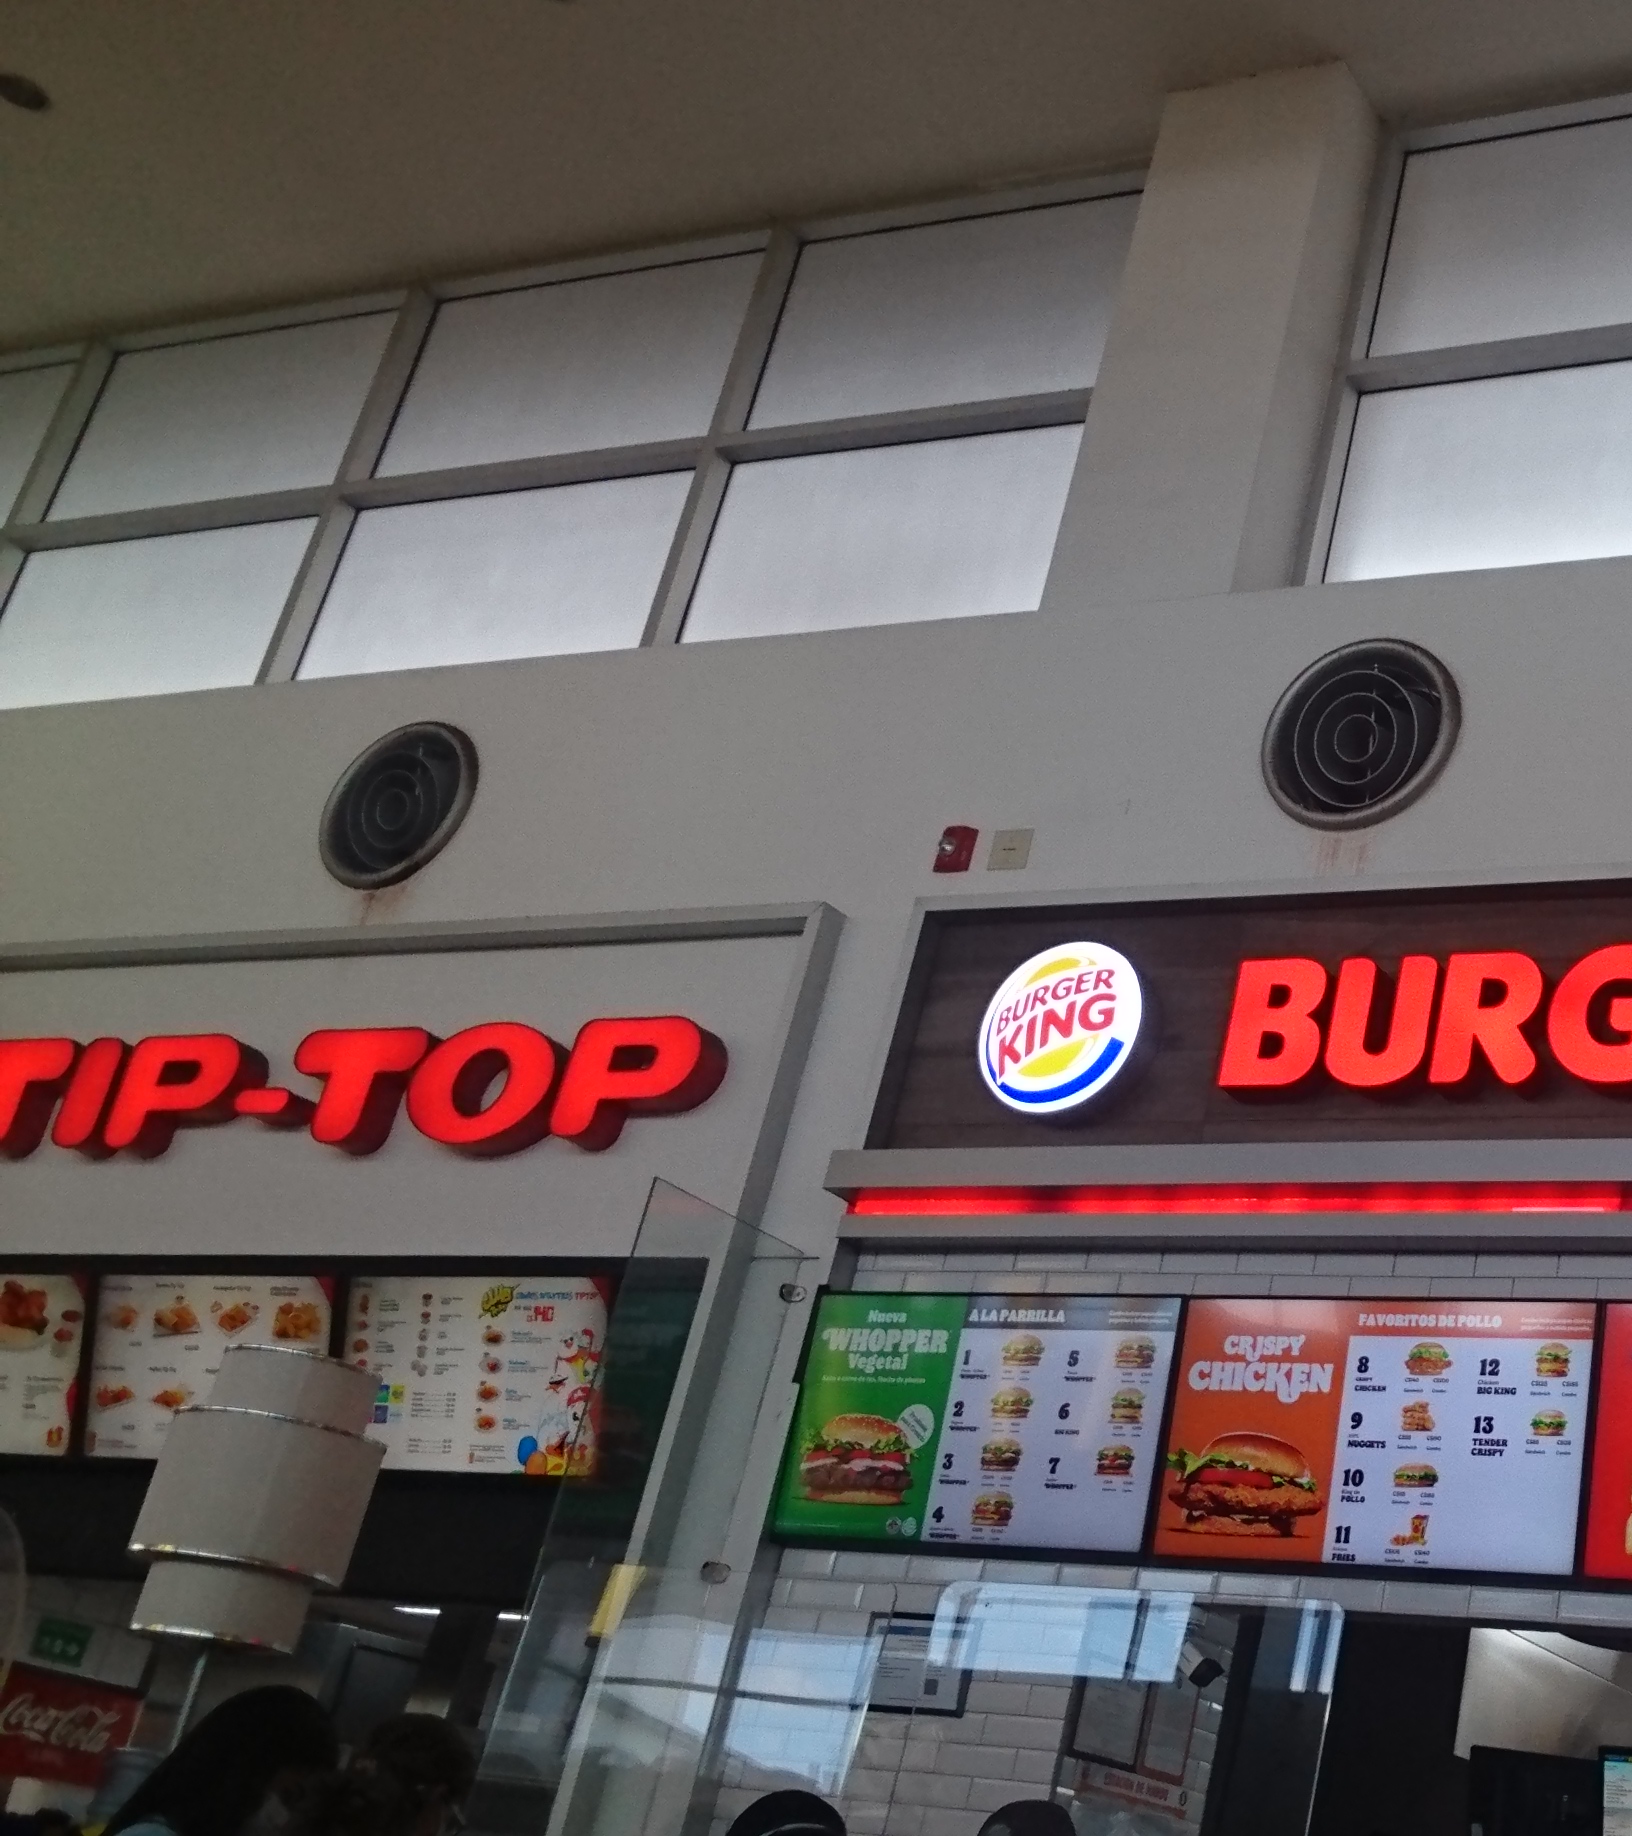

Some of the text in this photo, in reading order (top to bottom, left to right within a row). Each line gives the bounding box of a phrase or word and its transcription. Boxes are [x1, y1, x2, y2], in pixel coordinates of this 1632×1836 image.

[996, 968, 1116, 1037] BURGER
[999, 993, 1117, 1079] KING
[868, 1310, 907, 1323] Nueva
[969, 1309, 1065, 1322] A LA PARRILLA
[1359, 1313, 1502, 1328] FAVORITOS DE POLLO
[822, 1327, 949, 1353] WHOPPER
[1223, 1334, 1306, 1362] CRISPY
[848, 1353, 909, 1374] Vegetal
[963, 1350, 971, 1365] 1
[1068, 1350, 1079, 1367] 5
[1357, 1356, 1370, 1373] 8
[1480, 1358, 1500, 1376] 12
[1188, 1361, 1334, 1404] CHICKEN
[1476, 1387, 1517, 1395] BIG KING
[953, 1400, 964, 1417] 2
[1058, 1403, 1071, 1420] 6
[1350, 1412, 1363, 1430] 9
[1473, 1415, 1494, 1434] 13
[1347, 1440, 1386, 1449] NUGGETS
[1472, 1438, 1508, 1447] TENDER
[1471, 1448, 1505, 1456] CRISPY
[942, 1453, 955, 1469] 3
[1048, 1457, 1061, 1474] 7
[1342, 1468, 1364, 1487] 10
[1340, 1495, 1365, 1503] POLLO
[932, 1506, 945, 1523] 4
[1335, 1525, 1351, 1544] 11
[1331, 1553, 1356, 1562] FRIES
